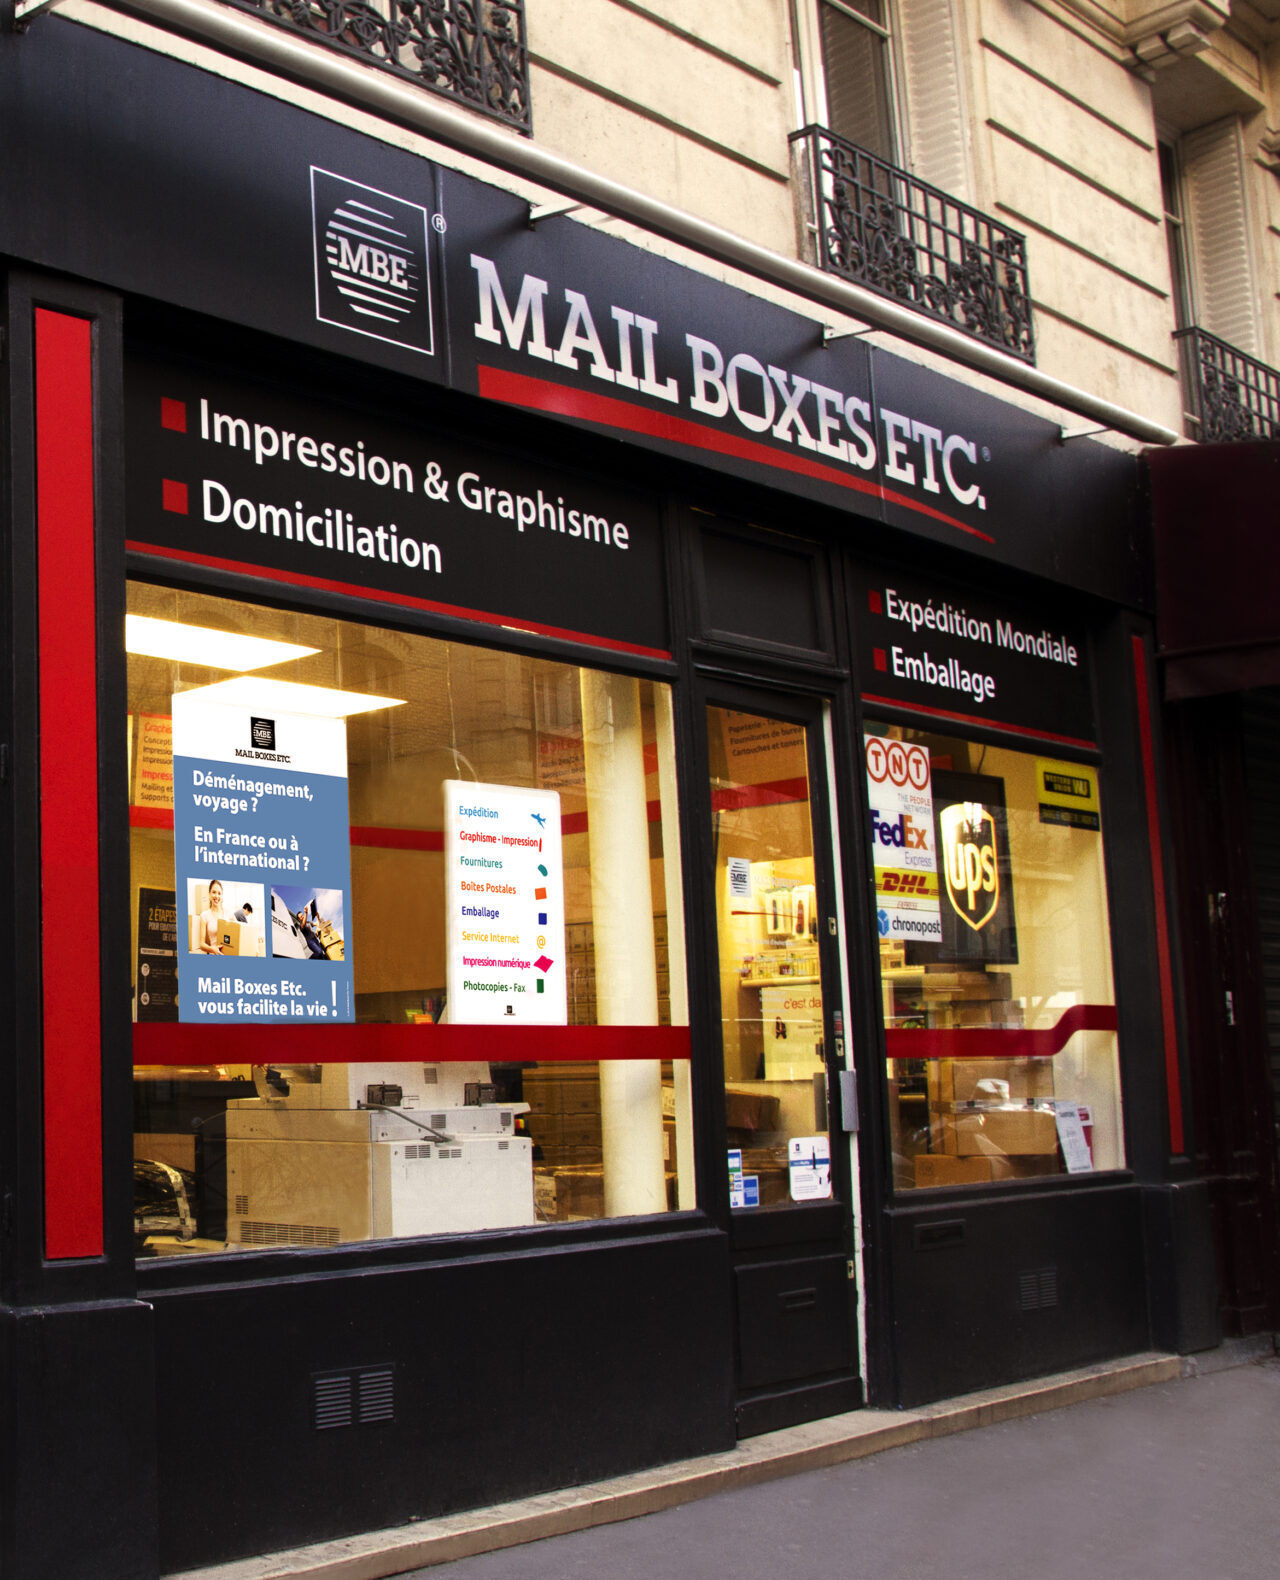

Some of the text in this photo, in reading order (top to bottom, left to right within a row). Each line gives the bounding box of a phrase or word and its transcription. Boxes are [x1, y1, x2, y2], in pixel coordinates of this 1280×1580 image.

[338, 235, 410, 290] MBE
[469, 253, 988, 510] MAIL BOXES ETC.
[200, 398, 630, 550] Impression & Graphisme
[203, 479, 443, 573] Domiciliation
[885, 588, 1078, 667] Expédition Mondiale
[891, 646, 996, 703] Emballage
[255, 729, 272, 739] MBE
[235, 748, 255, 758] MAIL
[255, 751, 277, 761] BOXES
[193, 770, 314, 802] Déménagement,
[193, 793, 258, 814] voyage ?
[910, 795, 931, 807] PEOPLE
[459, 805, 499, 819] Expédition
[194, 826, 299, 851] En France ou à
[460, 830, 497, 844] Graphisme
[502, 834, 538, 847] Impression
[869, 809, 929, 851] FedEx
[194, 845, 310, 872] l'international ?
[460, 856, 503, 869] Fournitures
[905, 851, 933, 867] Express
[882, 872, 930, 895] DHL
[949, 843, 997, 910] ups
[461, 881, 517, 895] Boîtes Postales
[461, 906, 499, 919] Emballage
[892, 915, 941, 936] chronopost
[462, 930, 520, 944] Service Internet
[463, 955, 531, 970] Impression numérique
[198, 977, 307, 996] Mail Boxes Etc.
[463, 980, 508, 994] Photocopies
[513, 982, 526, 993] Fax
[198, 1001, 234, 1015] vous
[237, 998, 288, 1016] facilite
[290, 1000, 304, 1016] la
[307, 1000, 328, 1017] vie
[331, 980, 338, 1017] !
